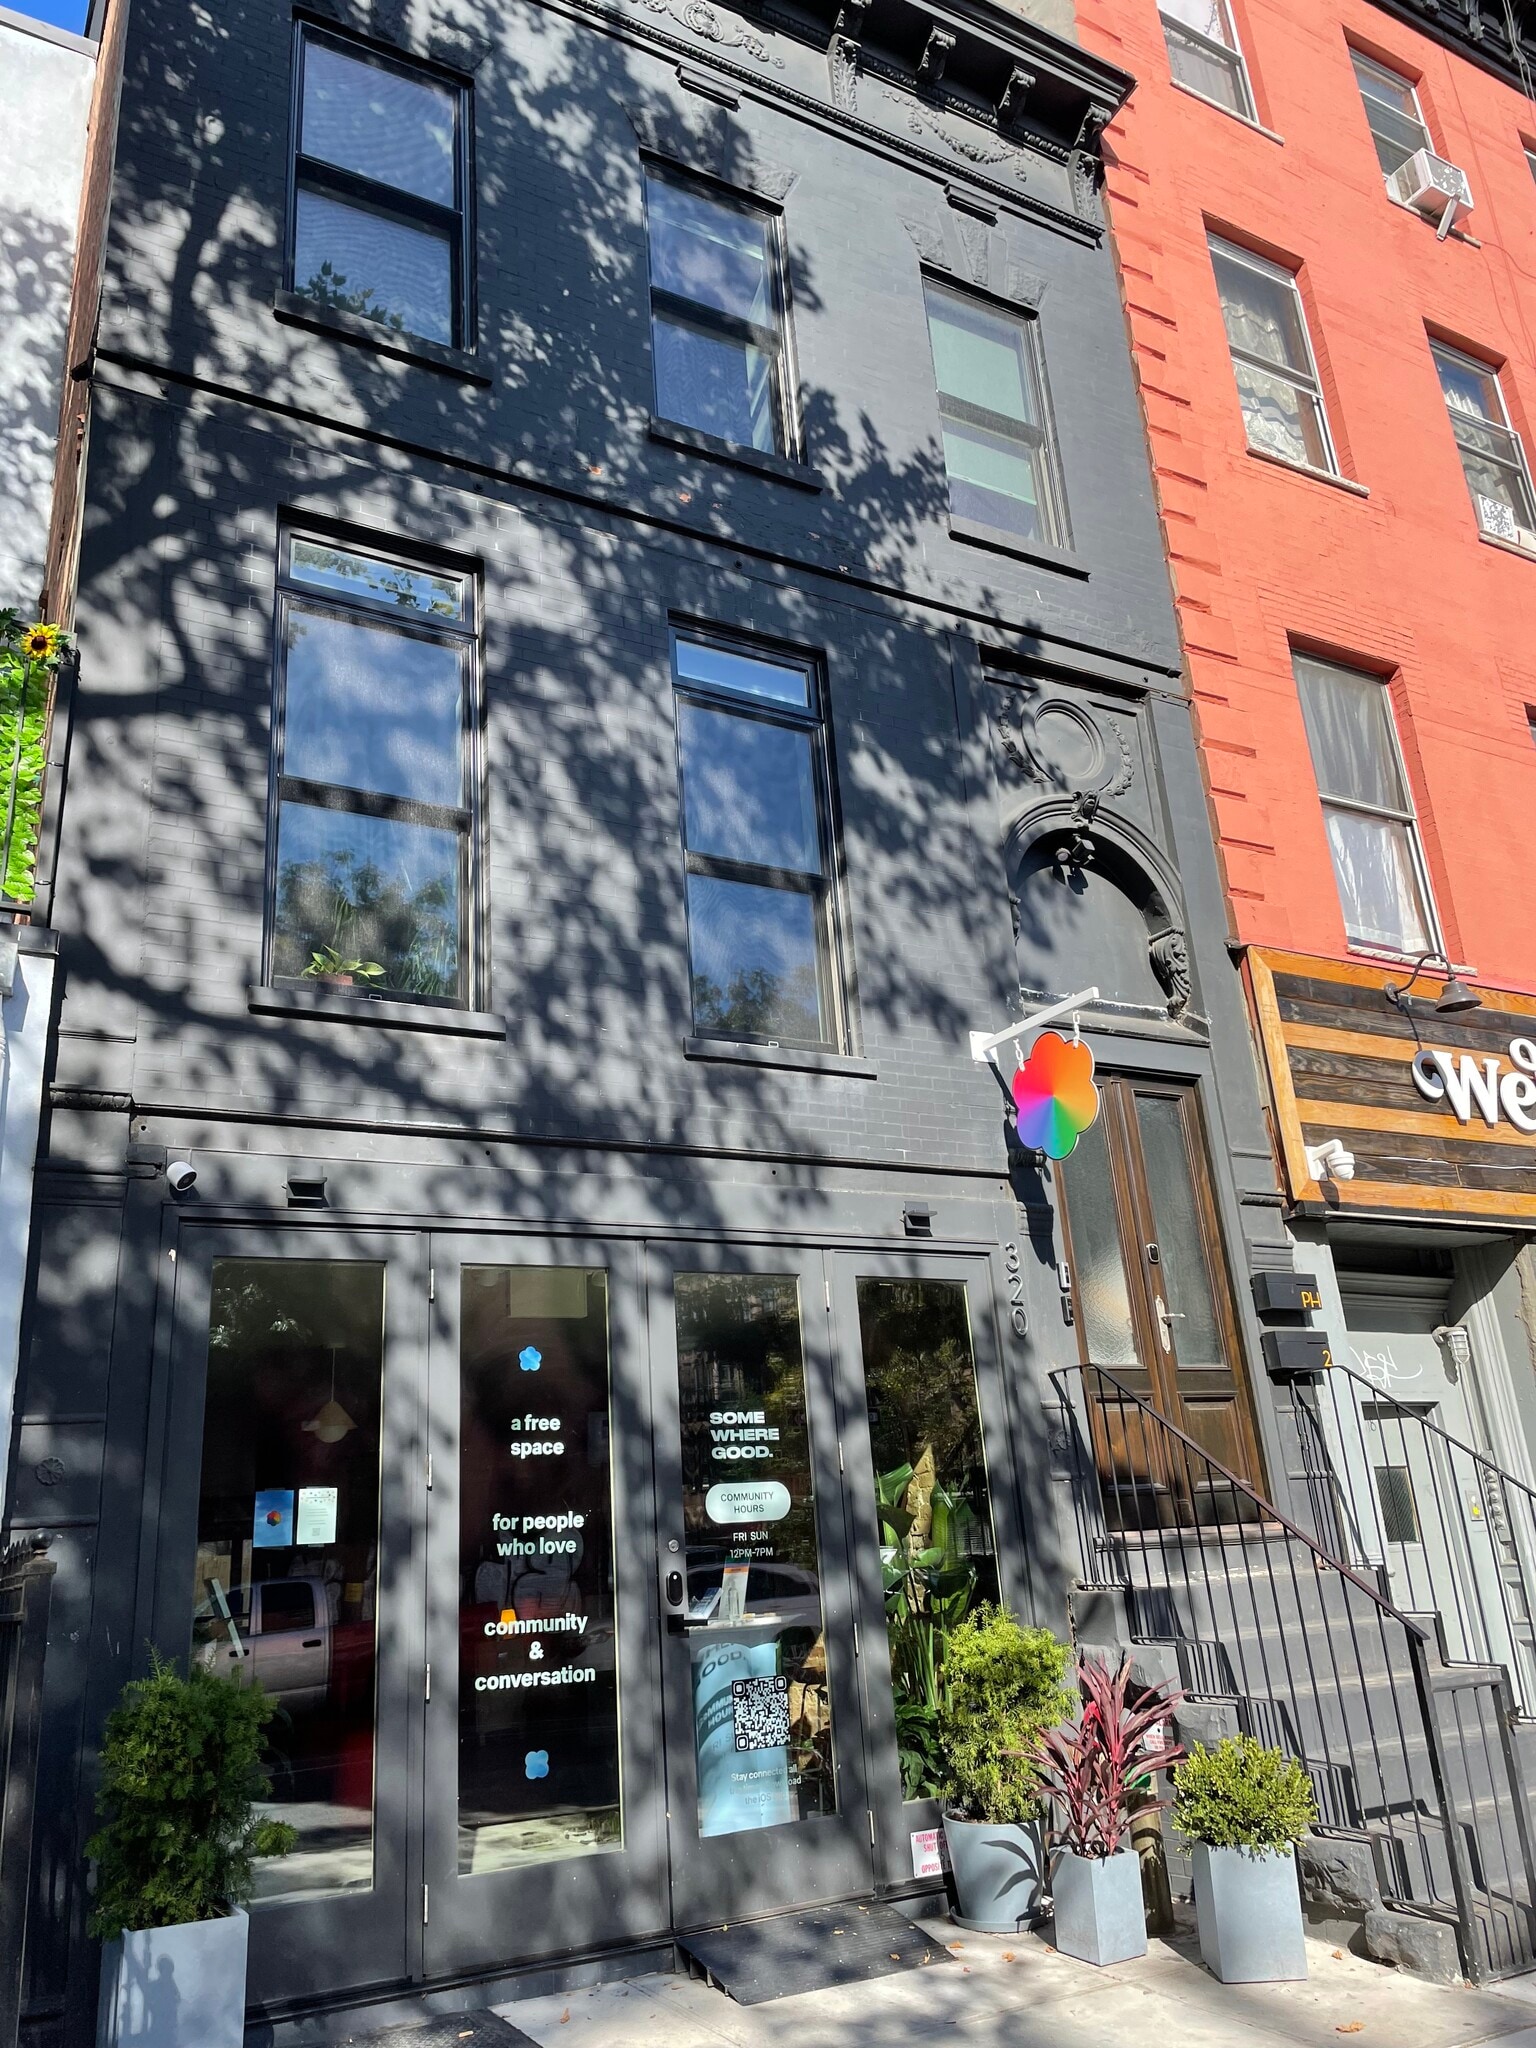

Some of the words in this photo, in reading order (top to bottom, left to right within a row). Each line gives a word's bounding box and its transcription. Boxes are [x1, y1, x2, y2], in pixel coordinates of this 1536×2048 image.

[1004, 1241, 1029, 1339] 320
[1301, 1291, 1322, 1308] PH
[1322, 1350, 1333, 1367] 2
[510, 1418, 522, 1431] a
[524, 1413, 561, 1431] free
[709, 1411, 765, 1425] SOME
[710, 1428, 780, 1442] WHERE
[510, 1439, 565, 1459] space
[711, 1445, 774, 1460] GOOD.
[720, 1491, 774, 1503] COMMUNITY
[733, 1504, 765, 1514] HOURS
[492, 1512, 519, 1531] for
[522, 1510, 585, 1534] people
[733, 1532, 747, 1542] FRI
[750, 1531, 769, 1541] SUN
[496, 1537, 536, 1556] who
[539, 1536, 577, 1555] love
[729, 1547, 774, 1559] 12PM-7PM
[483, 1612, 588, 1637] community
[529, 1641, 544, 1661] &
[474, 1666, 596, 1692] conversation
[731, 1773, 747, 1782] Stay
[788, 1764, 798, 1773] all
